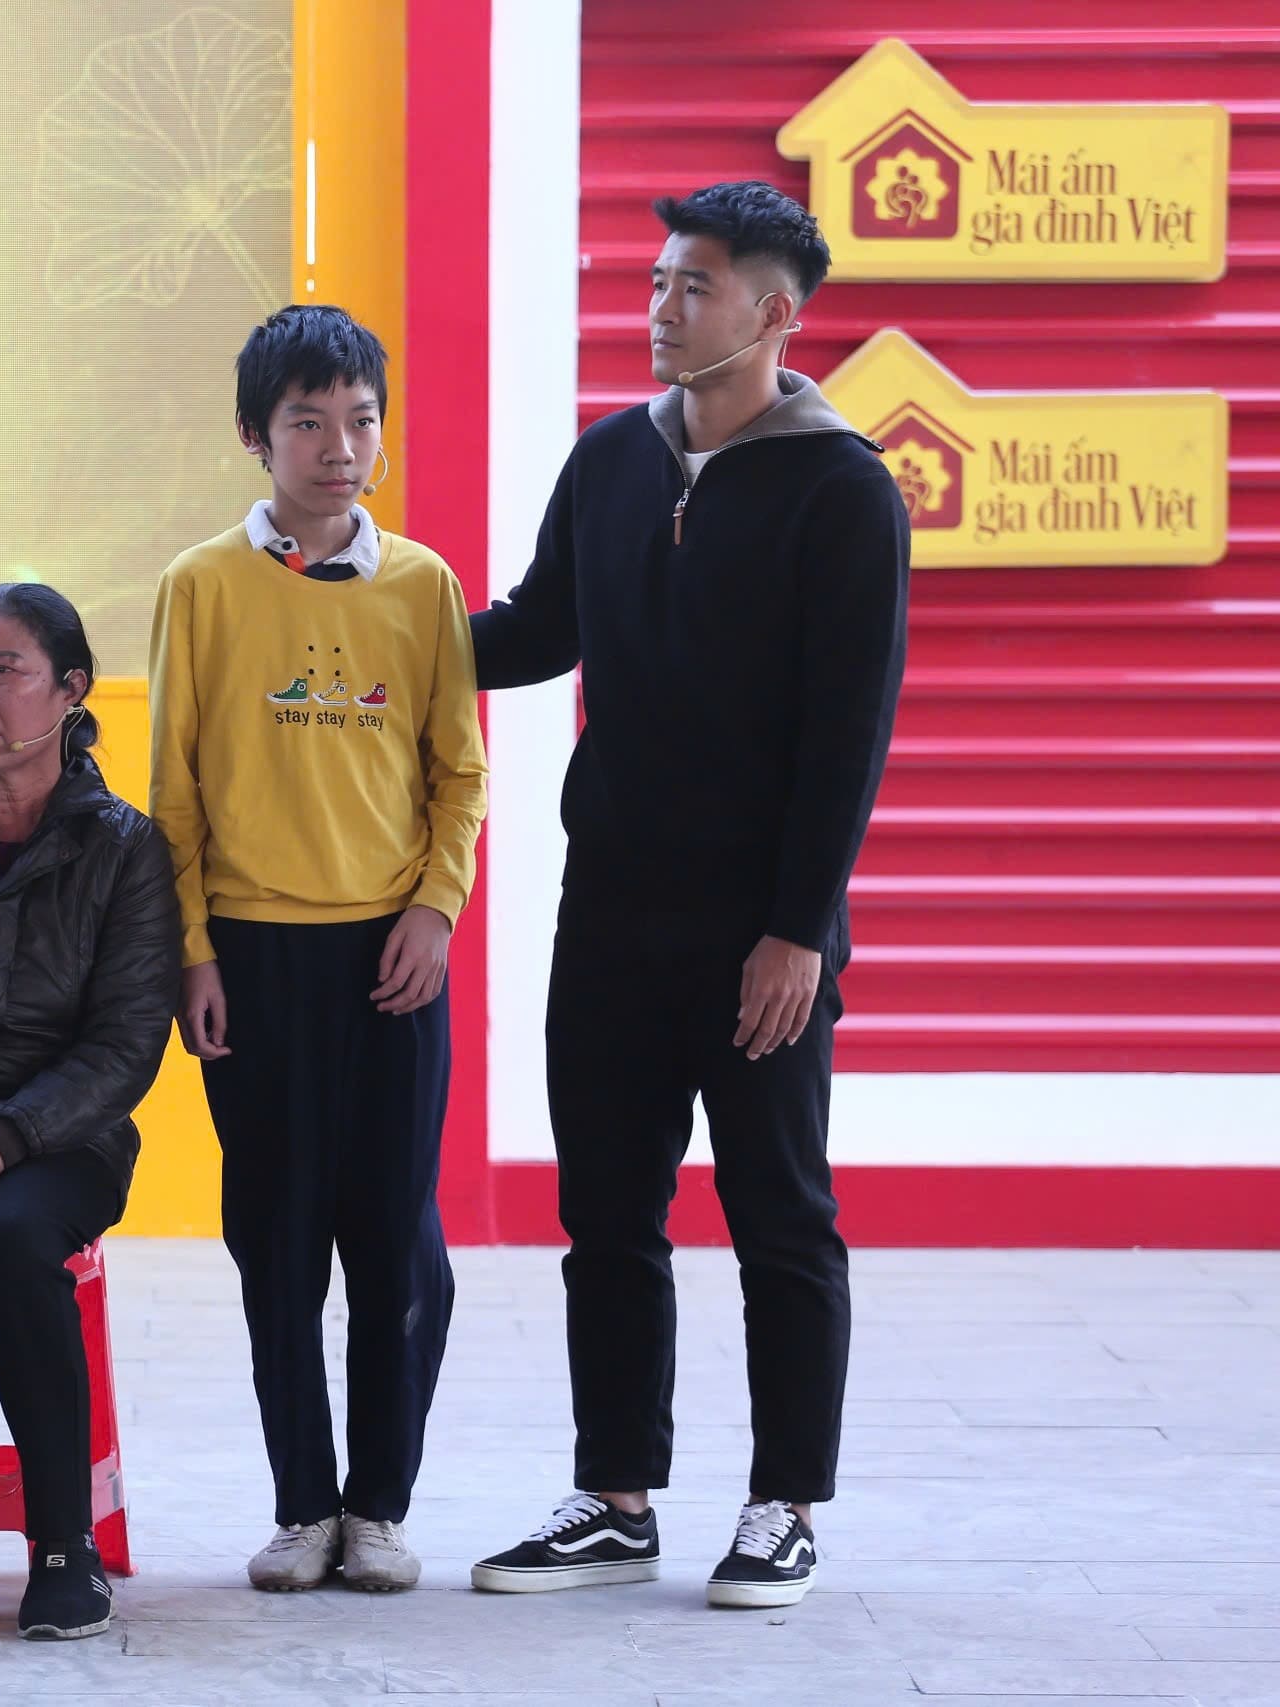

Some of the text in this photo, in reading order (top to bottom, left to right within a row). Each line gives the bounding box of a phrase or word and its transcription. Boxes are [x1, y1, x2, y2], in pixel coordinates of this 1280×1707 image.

[987, 147, 1116, 195] Mái ấm
[970, 198, 1197, 256] gia đình Việt
[990, 436, 1118, 485] Mái ấm
[974, 484, 1197, 545] gia đình Việt
[275, 708, 384, 731] stay stay stay
